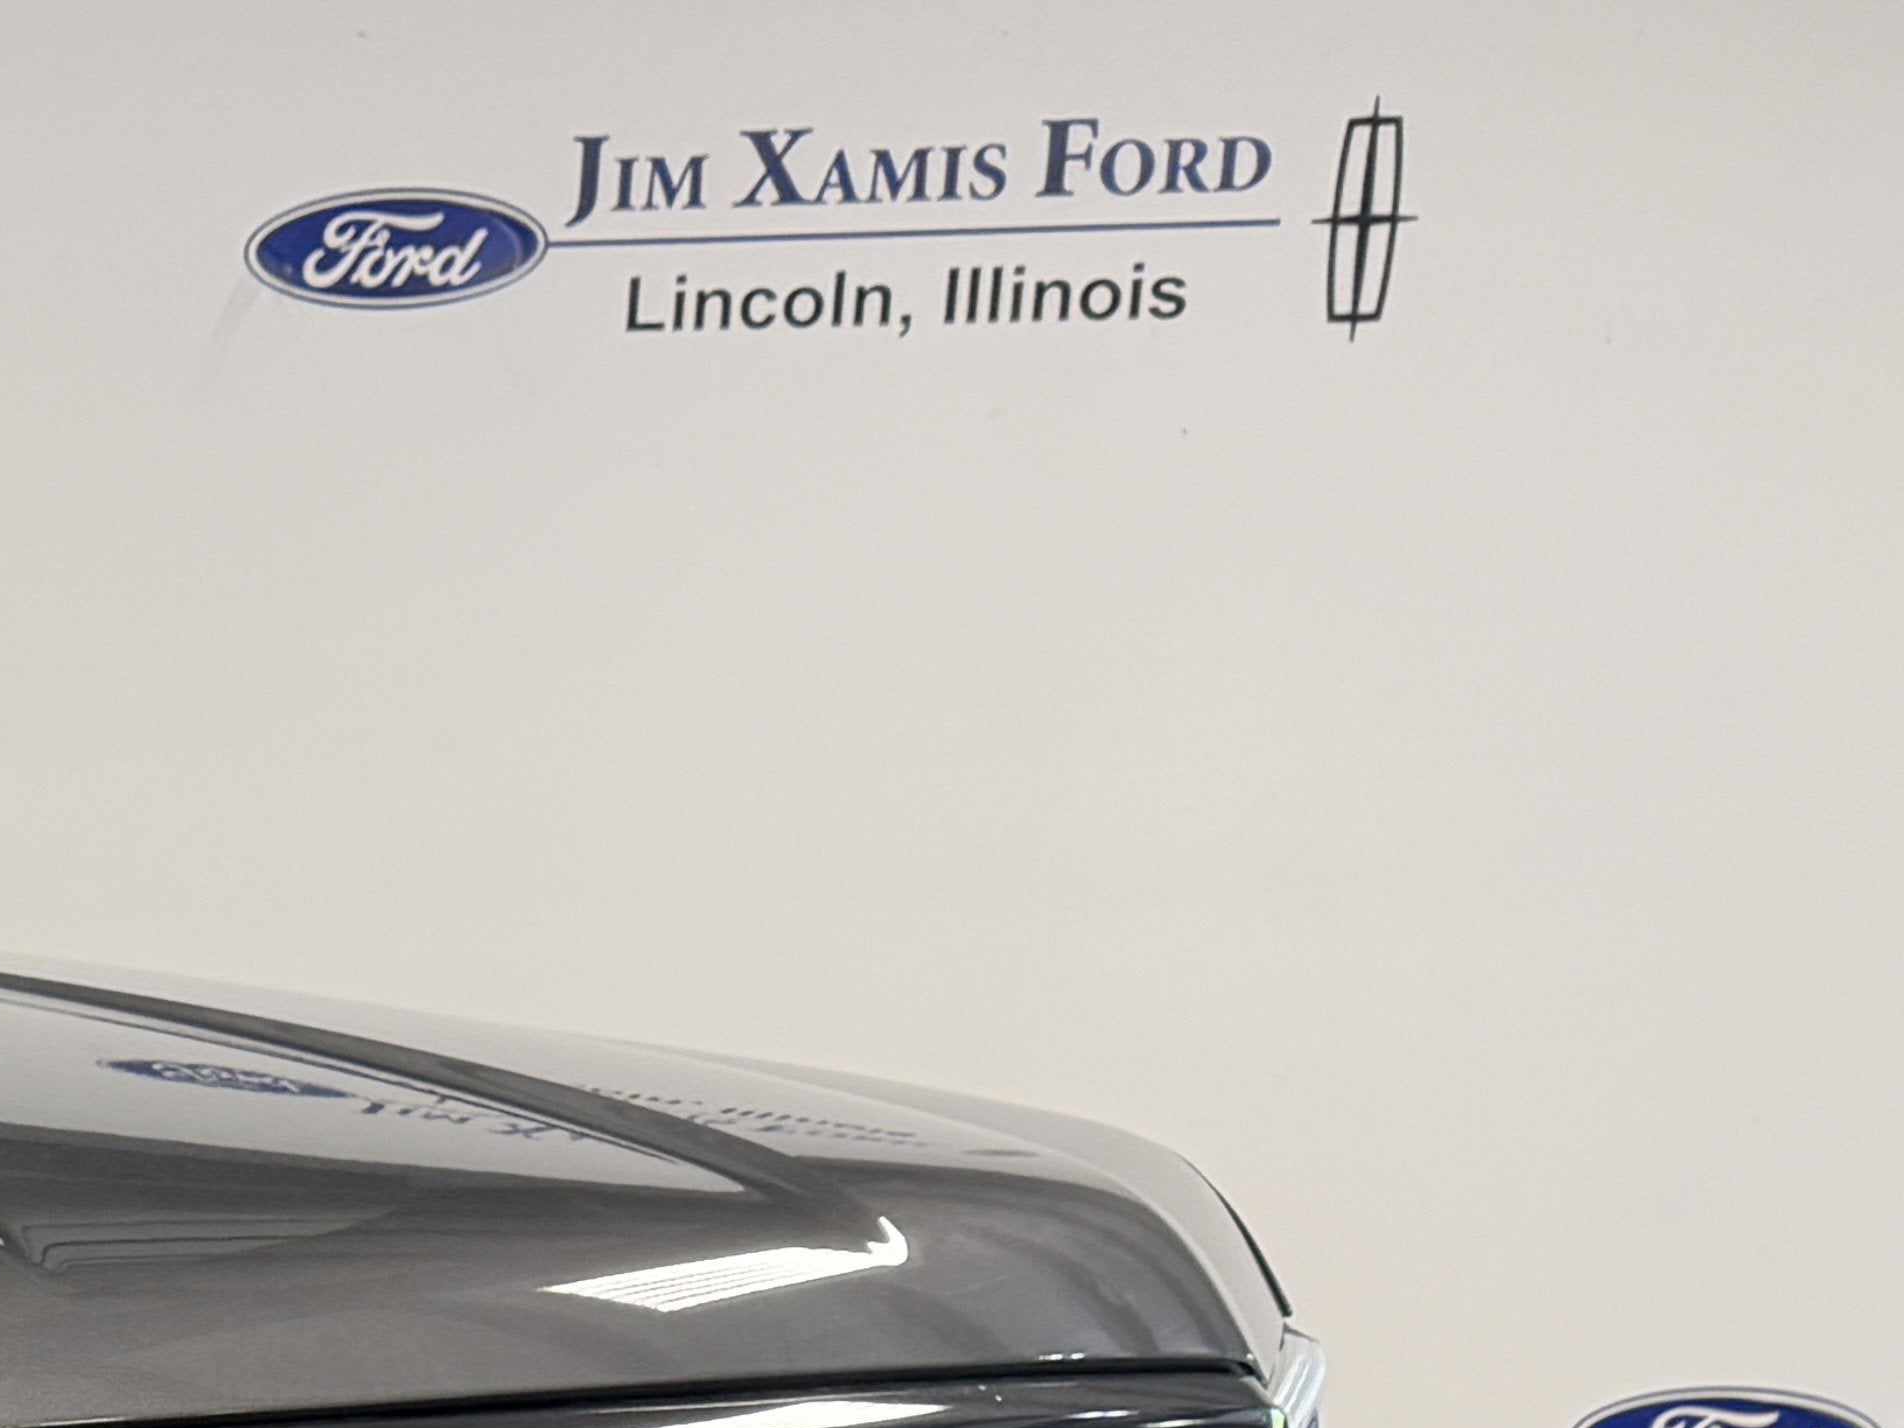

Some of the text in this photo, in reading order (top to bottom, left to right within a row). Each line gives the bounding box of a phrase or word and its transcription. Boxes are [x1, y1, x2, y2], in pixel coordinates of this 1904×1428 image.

[565, 117, 1272, 228] JIM XAMIS FORD
[302, 210, 489, 289] Ford
[625, 261, 1188, 338] Lincoln, Illinois
